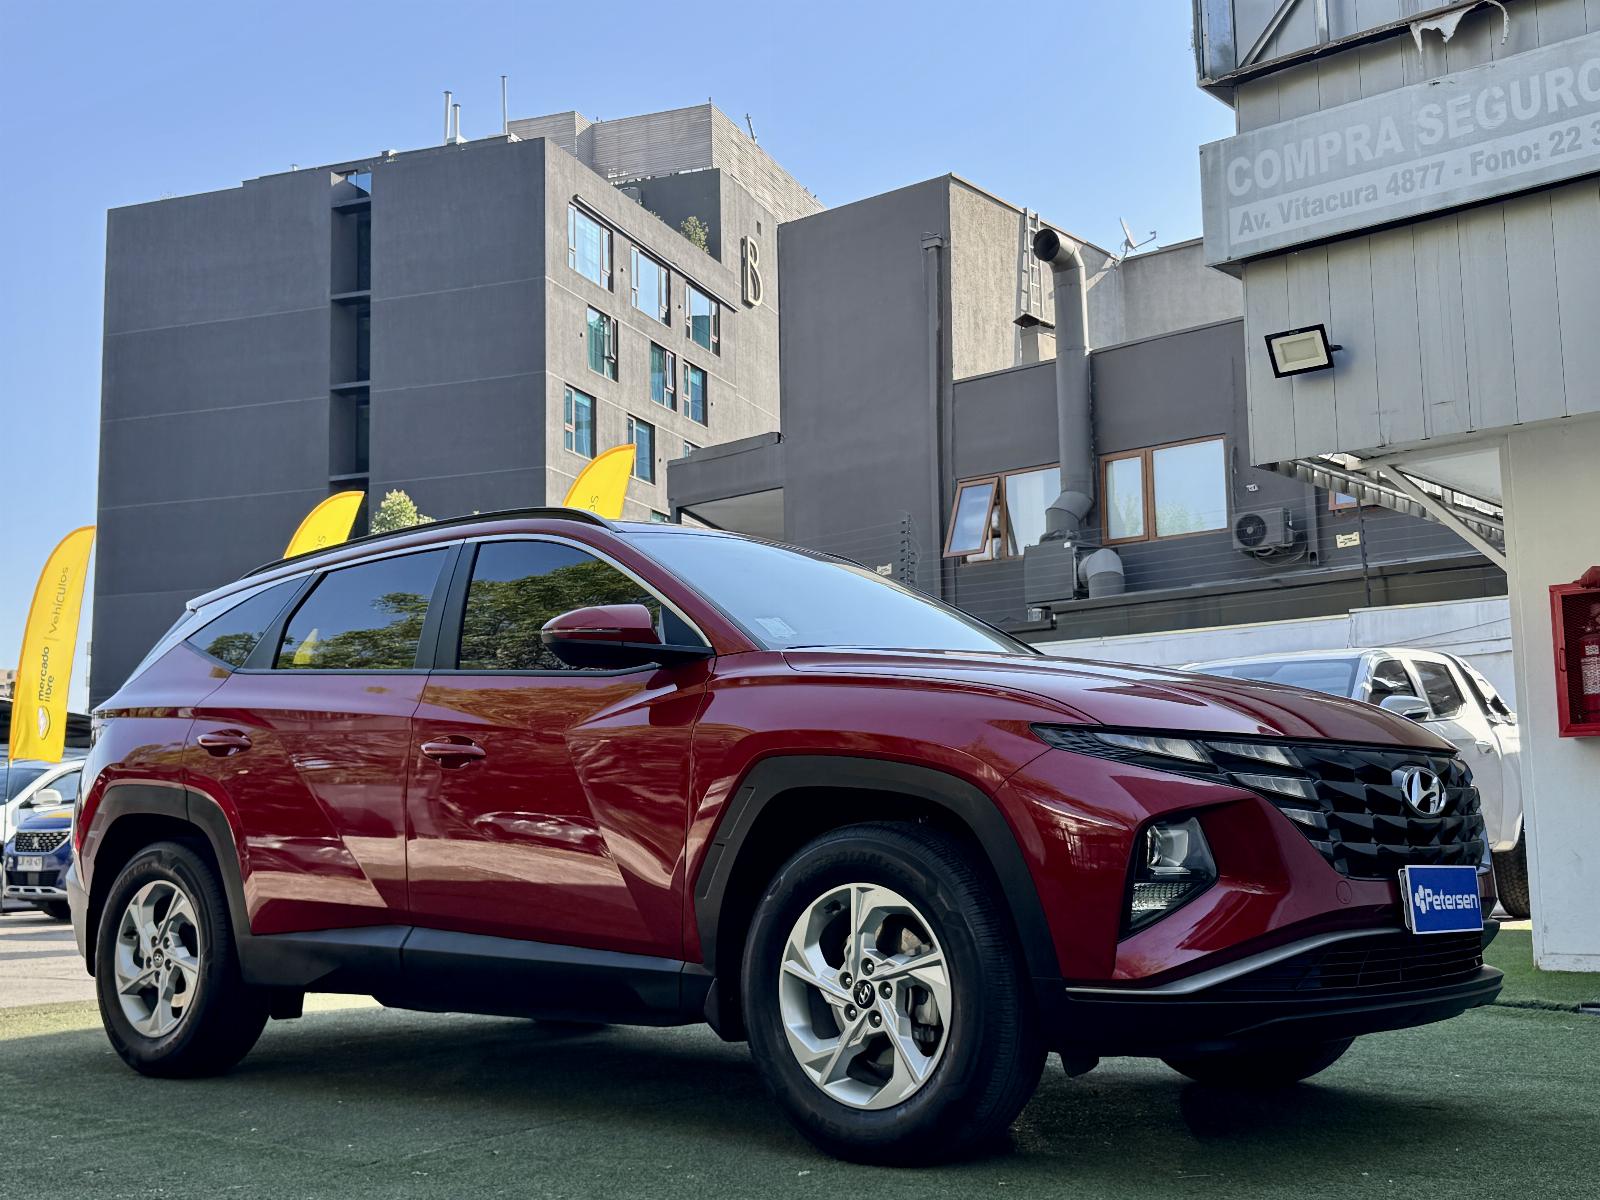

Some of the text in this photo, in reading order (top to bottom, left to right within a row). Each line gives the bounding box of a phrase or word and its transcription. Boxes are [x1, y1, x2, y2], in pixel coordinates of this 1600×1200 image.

[1227, 58, 1600, 197] COMPRA SEGURO
[1238, 211, 1270, 236] Av.
[1278, 184, 1378, 224] Vitacura
[1386, 160, 1446, 195] 4877
[1470, 142, 1540, 176] Fono:
[1549, 126, 1582, 157] 22
[38, 646, 55, 702] mercado libre
[1425, 888, 1478, 910] Petersen
